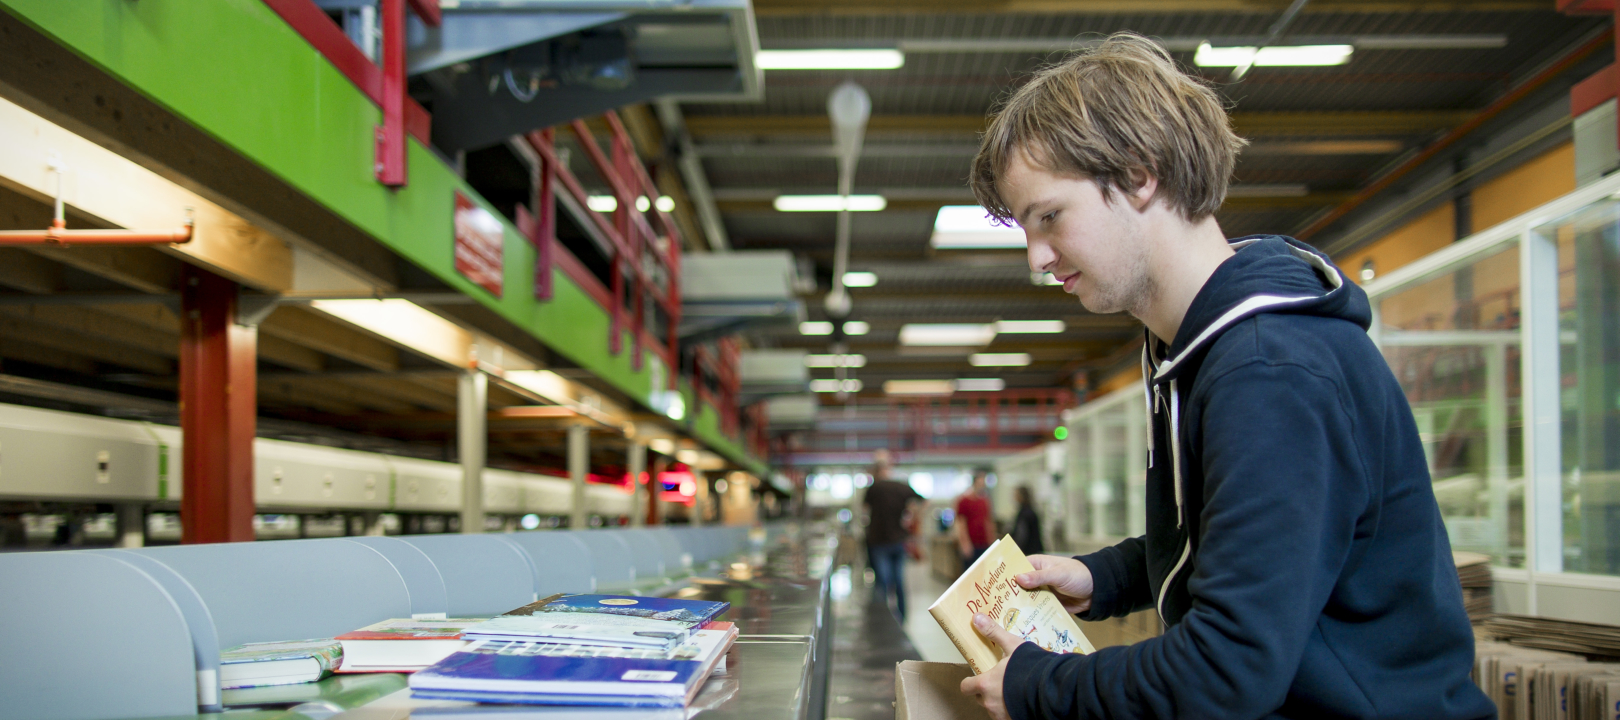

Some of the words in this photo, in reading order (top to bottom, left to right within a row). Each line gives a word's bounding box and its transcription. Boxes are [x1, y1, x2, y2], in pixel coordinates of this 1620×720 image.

[966, 599, 982, 614] De
[975, 562, 1006, 605] Avonturen
[995, 582, 1007, 592] van
[1004, 590, 1011, 601] en
[1005, 574, 1020, 597] Lo
[1023, 608, 1040, 627] Jacques
[1037, 595, 1050, 610] Vriens
[940, 619, 955, 640] Jacques
[955, 638, 967, 656] Vriens
